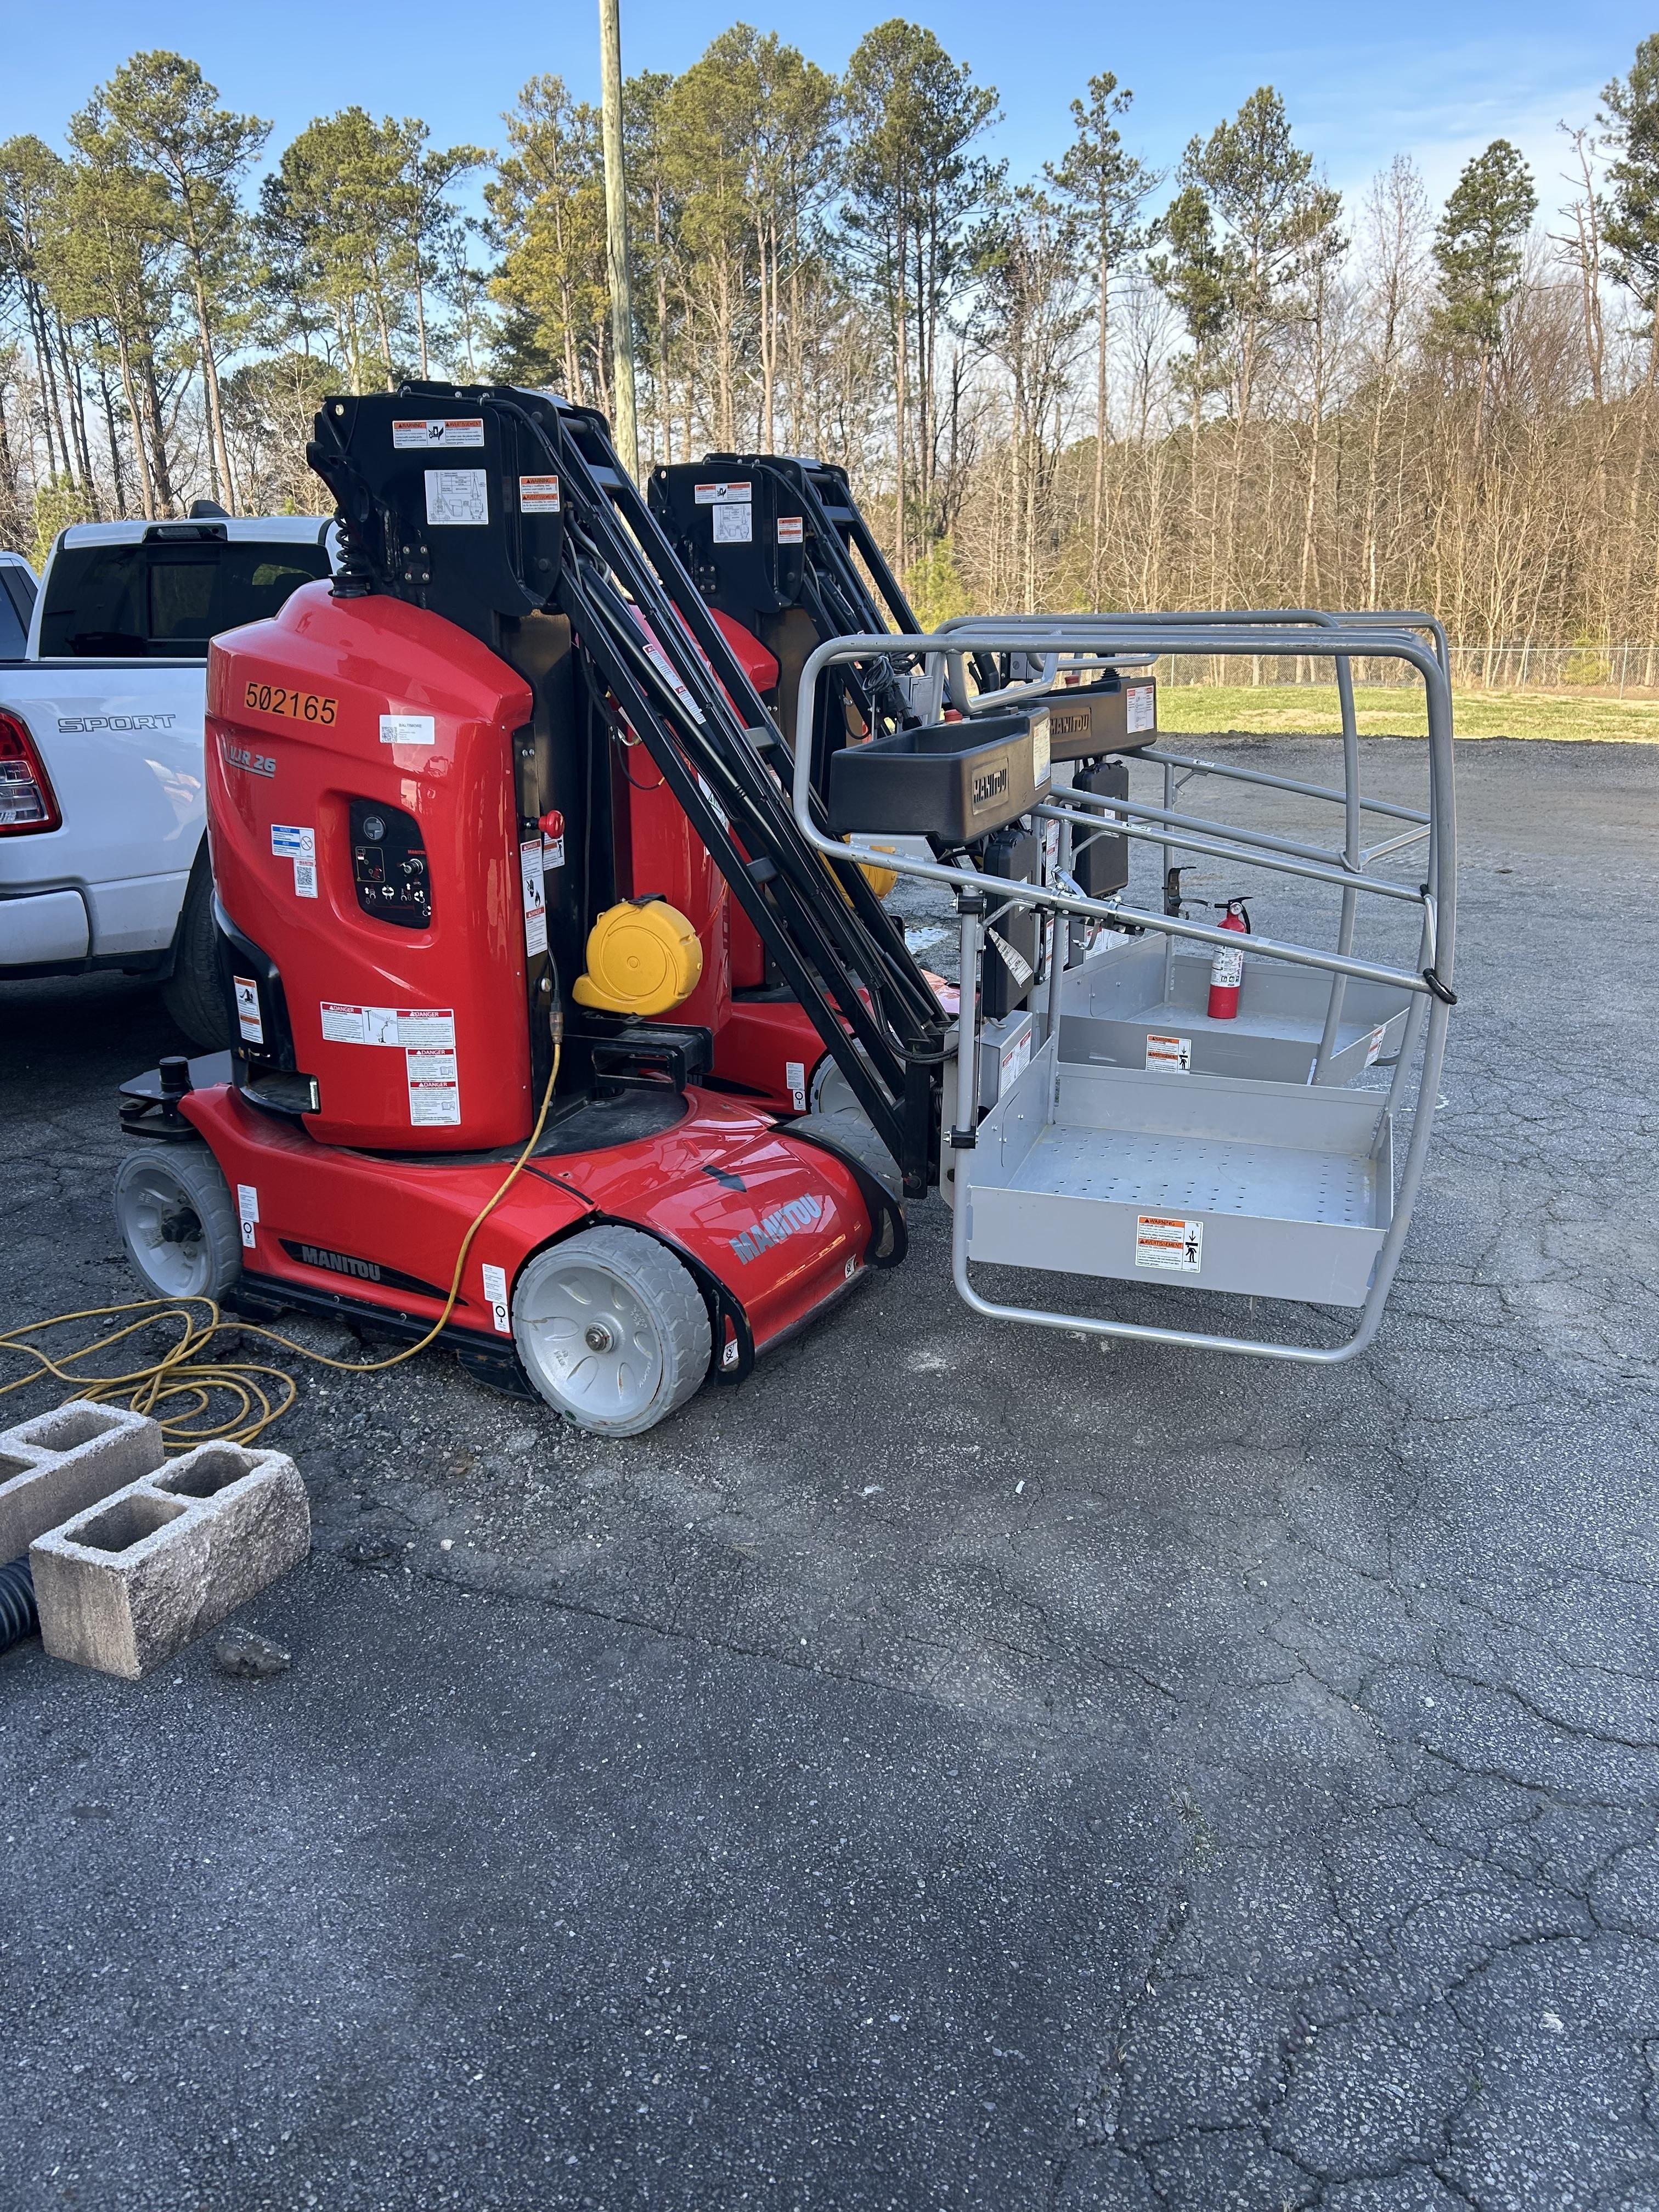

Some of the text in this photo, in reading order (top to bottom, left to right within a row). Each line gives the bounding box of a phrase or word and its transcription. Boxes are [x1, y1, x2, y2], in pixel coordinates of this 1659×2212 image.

[246, 682, 336, 724] 502165
[58, 714, 176, 733] SPORT
[253, 754, 276, 772] 26
[974, 768, 1007, 803] MANITOU
[729, 1193, 822, 1265] MANITOU
[1144, 1240, 1182, 1248] AVERTISSEMENT
[302, 1245, 381, 1281] MANITOU
